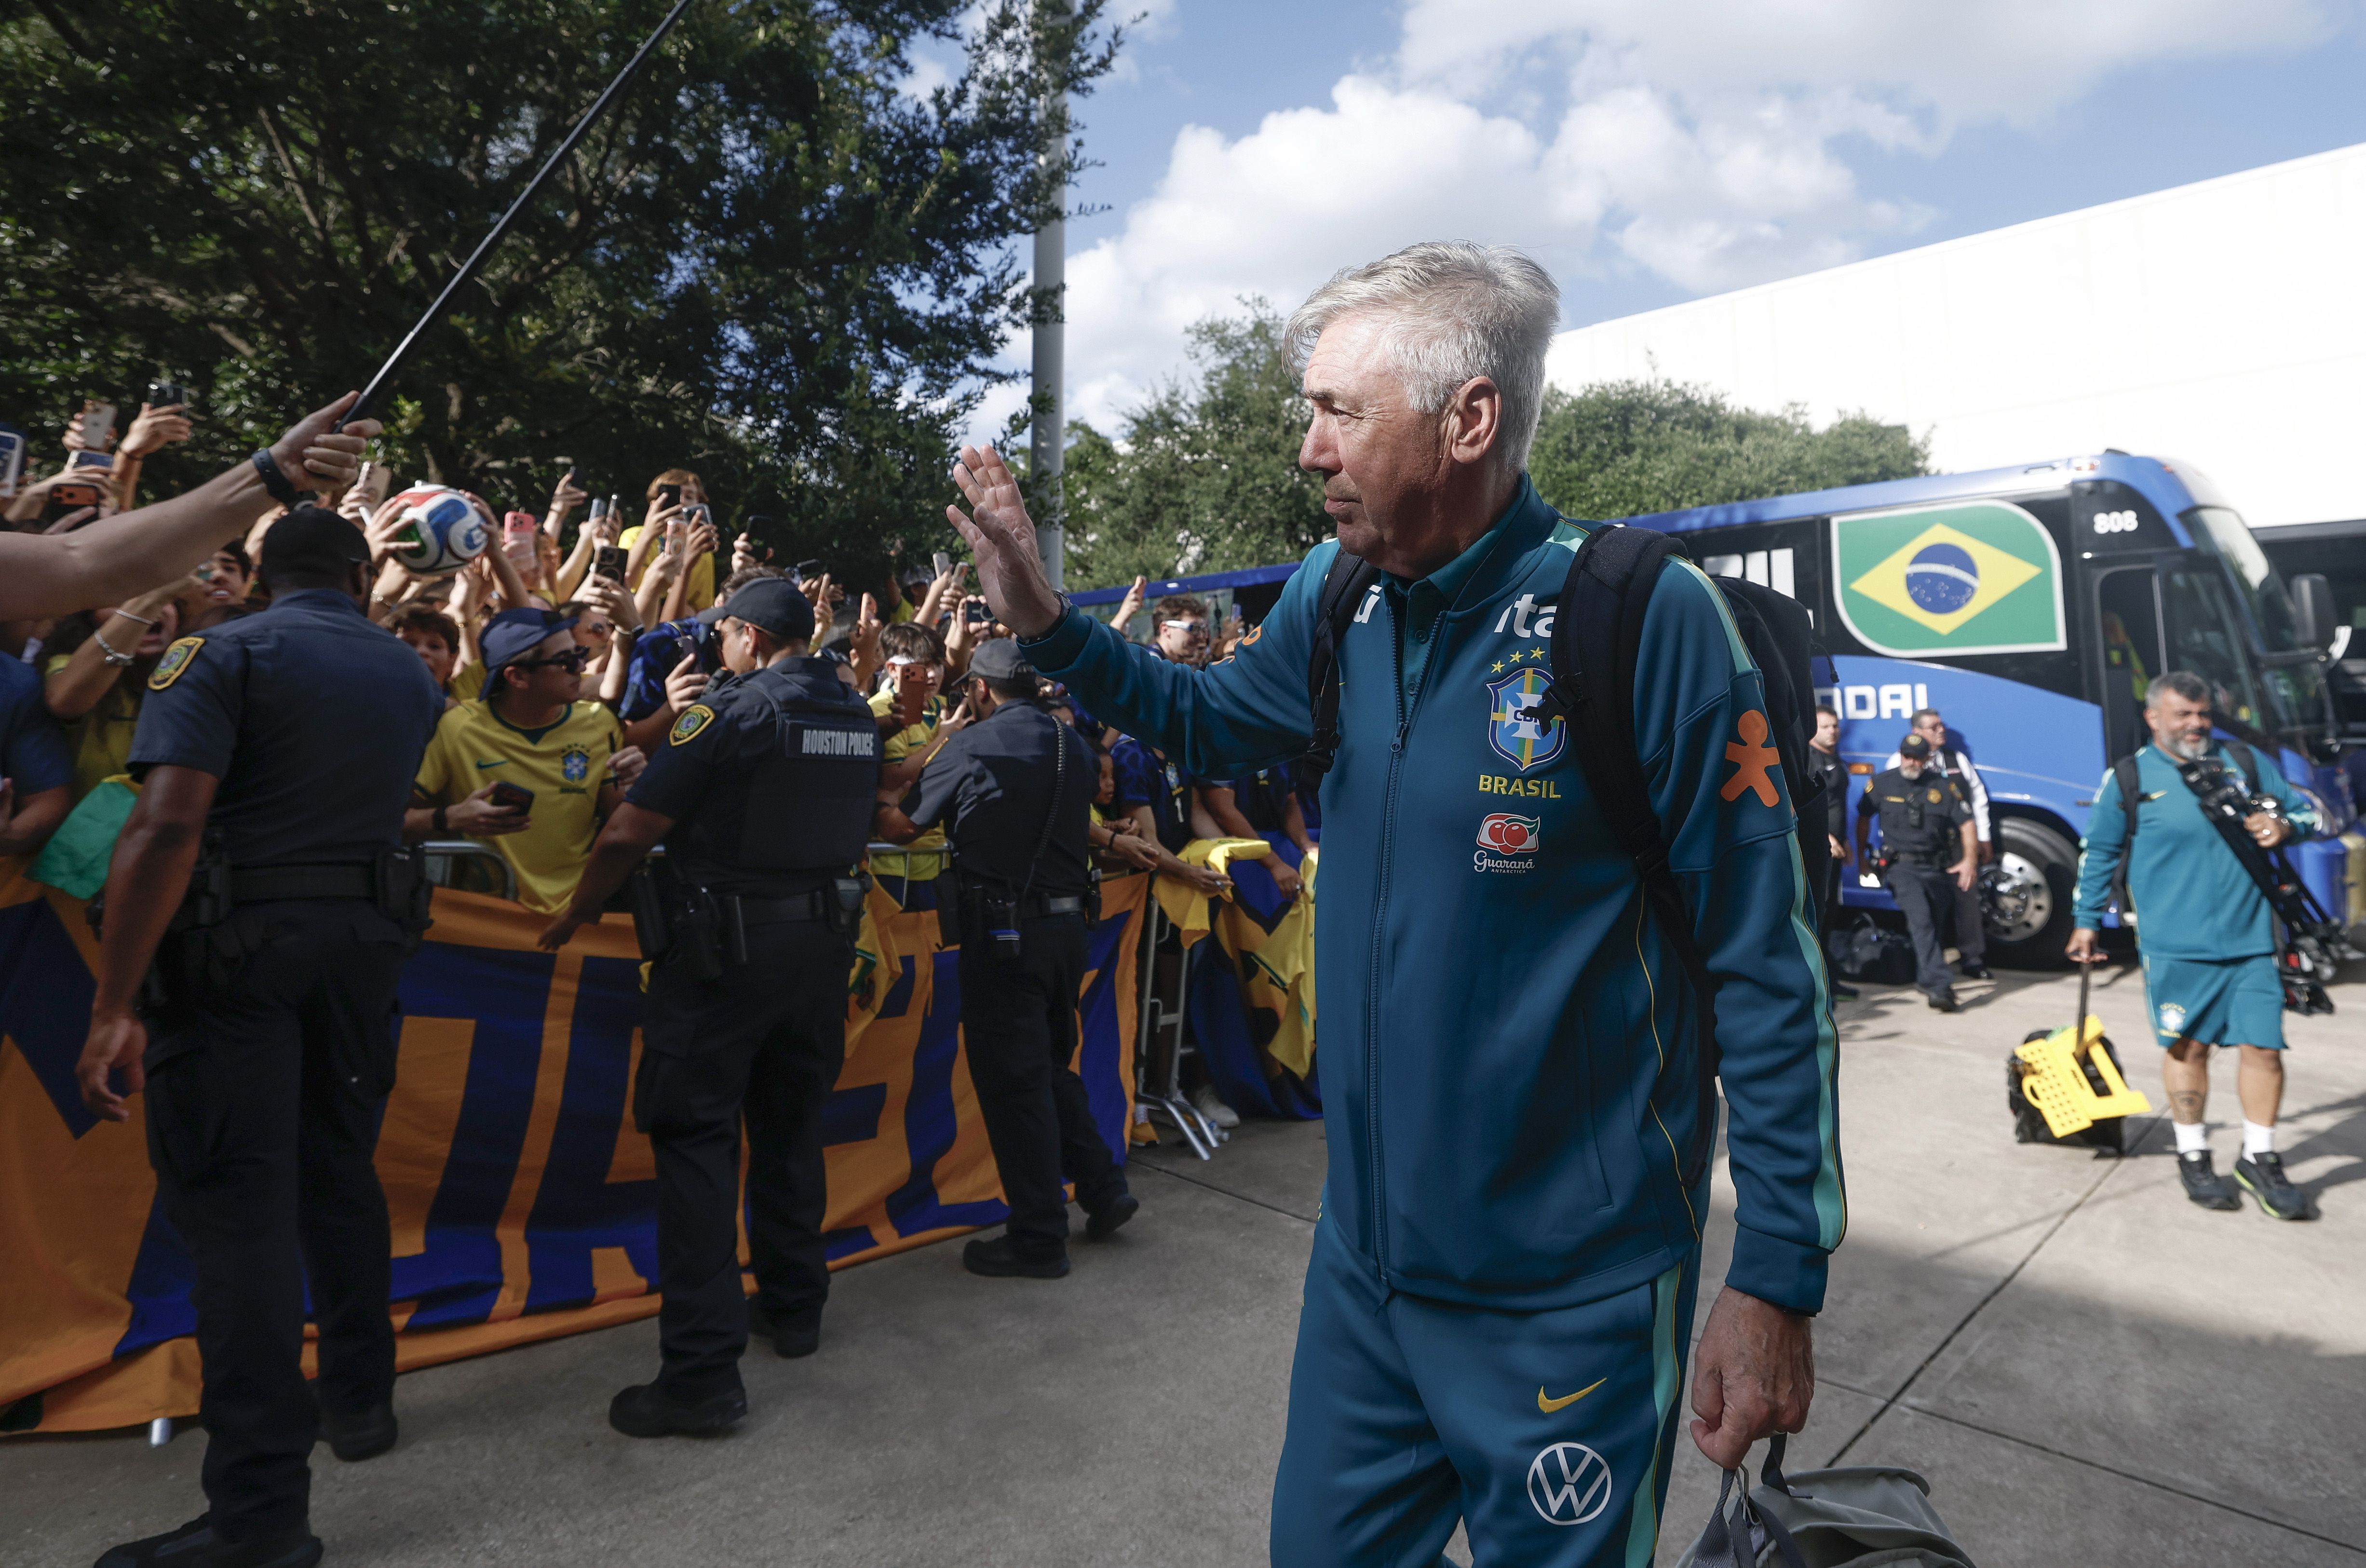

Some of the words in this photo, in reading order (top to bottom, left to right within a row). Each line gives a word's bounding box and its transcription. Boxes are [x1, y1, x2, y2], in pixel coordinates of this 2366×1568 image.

[2093, 509, 2138, 534] 808
[802, 729, 847, 756] HOUSTON
[847, 731, 874, 757] POLICE
[1478, 774, 1561, 799] BRASIL
[1474, 850, 1535, 873] Guaraná
